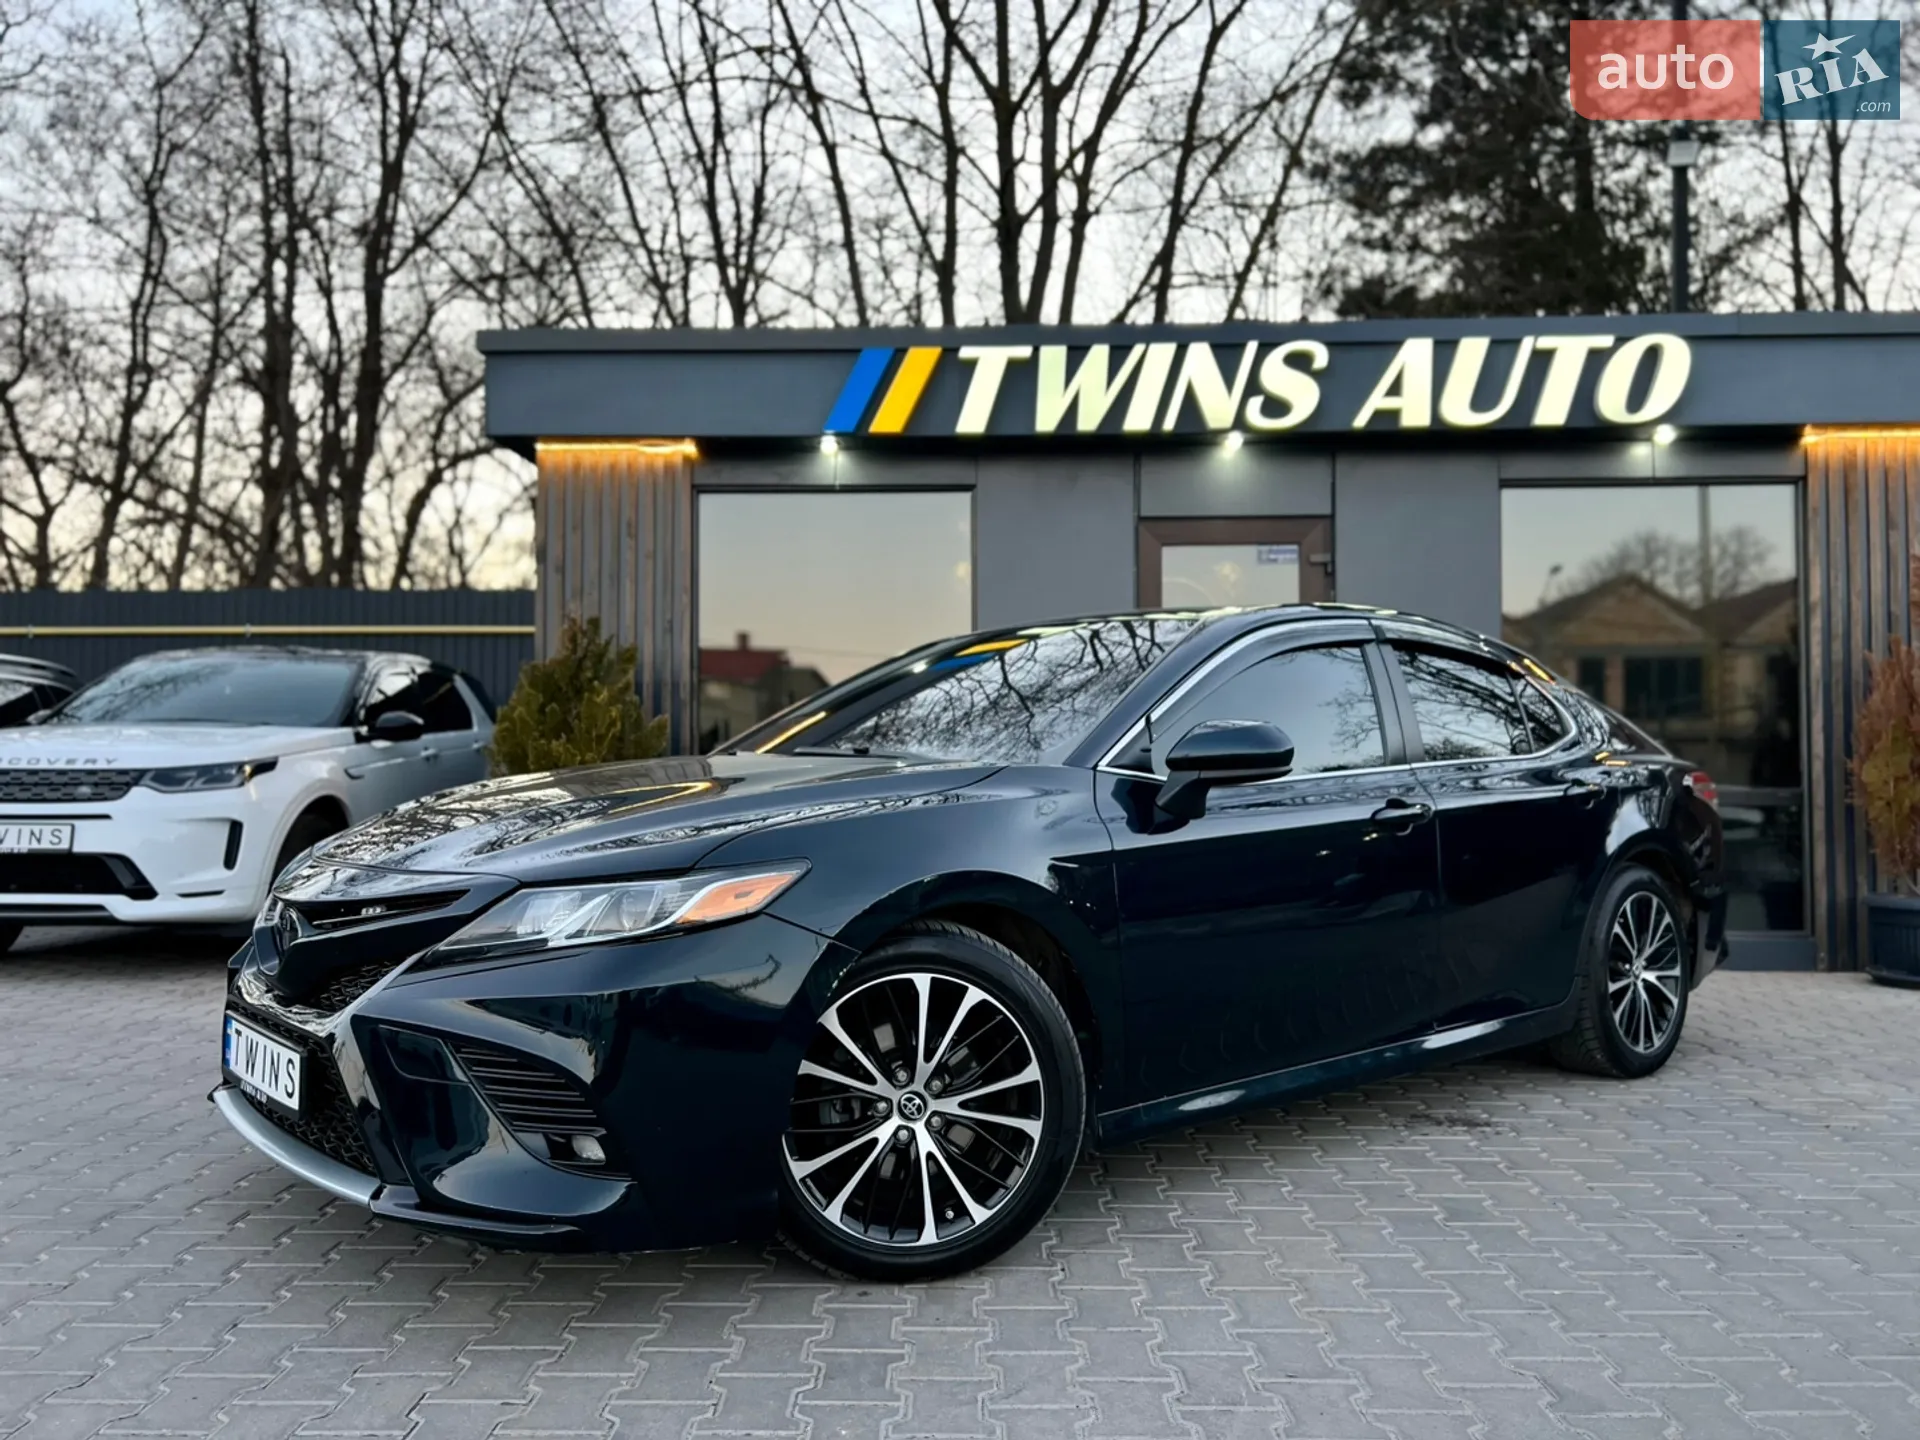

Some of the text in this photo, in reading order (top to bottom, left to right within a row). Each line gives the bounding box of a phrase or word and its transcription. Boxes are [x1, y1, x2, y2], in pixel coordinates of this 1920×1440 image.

[956, 332, 1692, 436] TWINS AUTO
[0, 757, 118, 766] COVERY
[234, 1028, 296, 1099] TWINS
